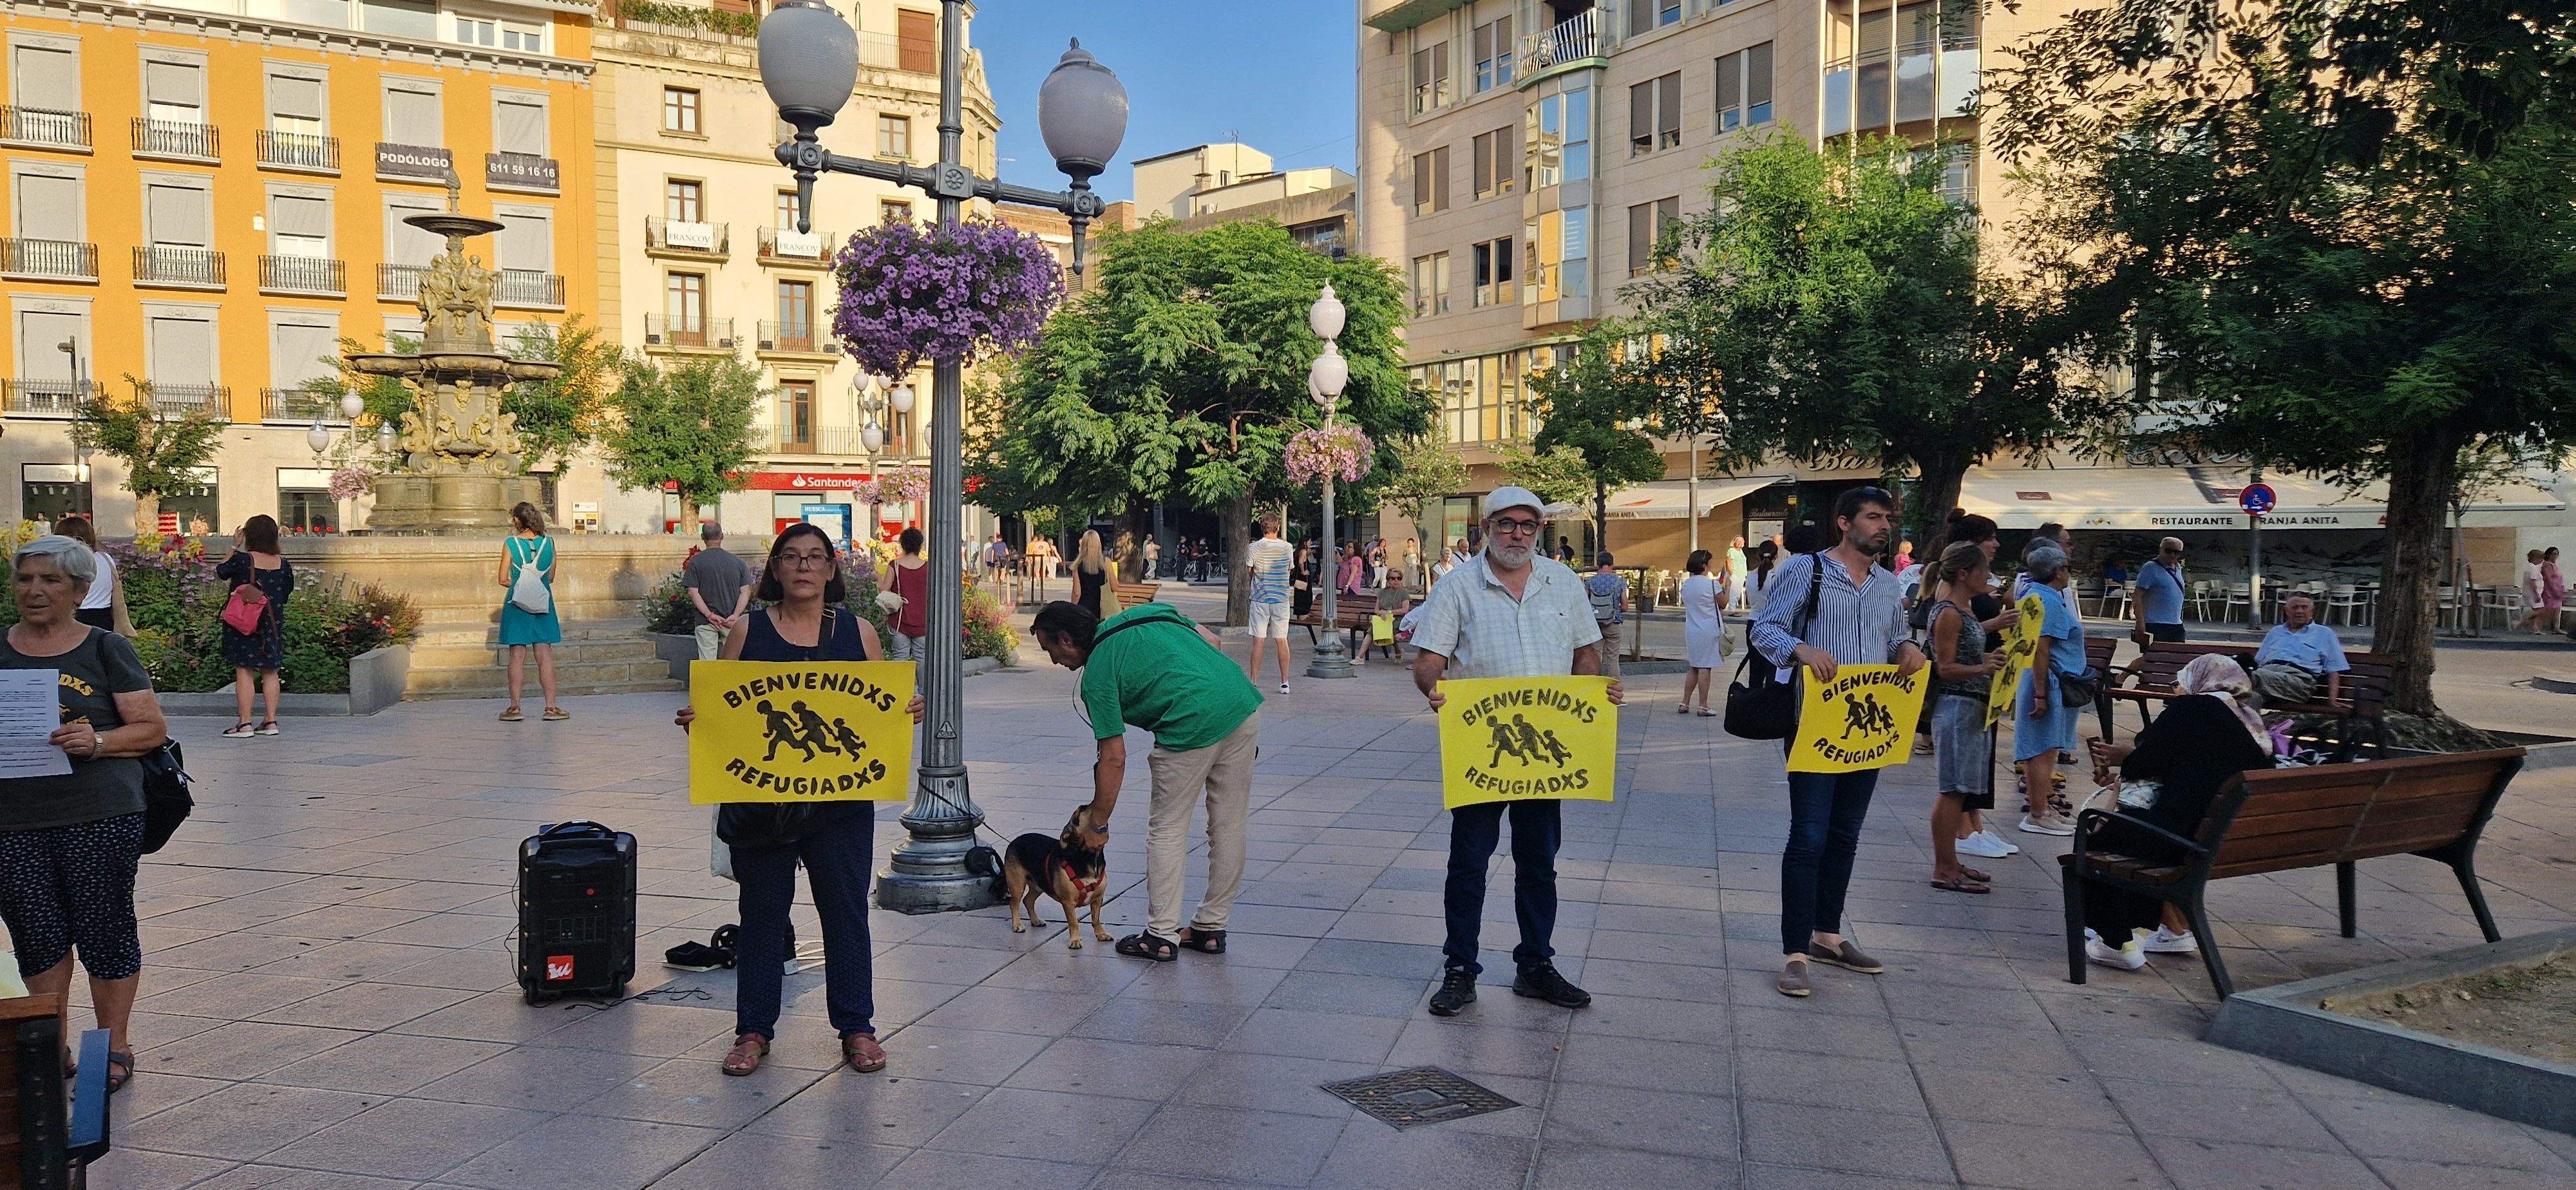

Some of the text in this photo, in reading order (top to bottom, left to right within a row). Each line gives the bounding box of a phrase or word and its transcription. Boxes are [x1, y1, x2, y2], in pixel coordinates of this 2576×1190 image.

[379, 152, 449, 168] PODÓLOGO
[489, 162, 556, 178] 611 59 16 16
[807, 477, 862, 487] Santander
[2151, 517, 2233, 525] RESTAURANTE
[723, 672, 896, 712] BIENVENIDXS
[1822, 671, 1915, 703] BIENVENIDXS
[1461, 688, 1598, 726] BIENVENIDXS
[1813, 730, 1900, 764] REFUGIADXS
[725, 758, 886, 795] REFUGIADXS
[1464, 766, 1589, 795] REFUGIADXS
